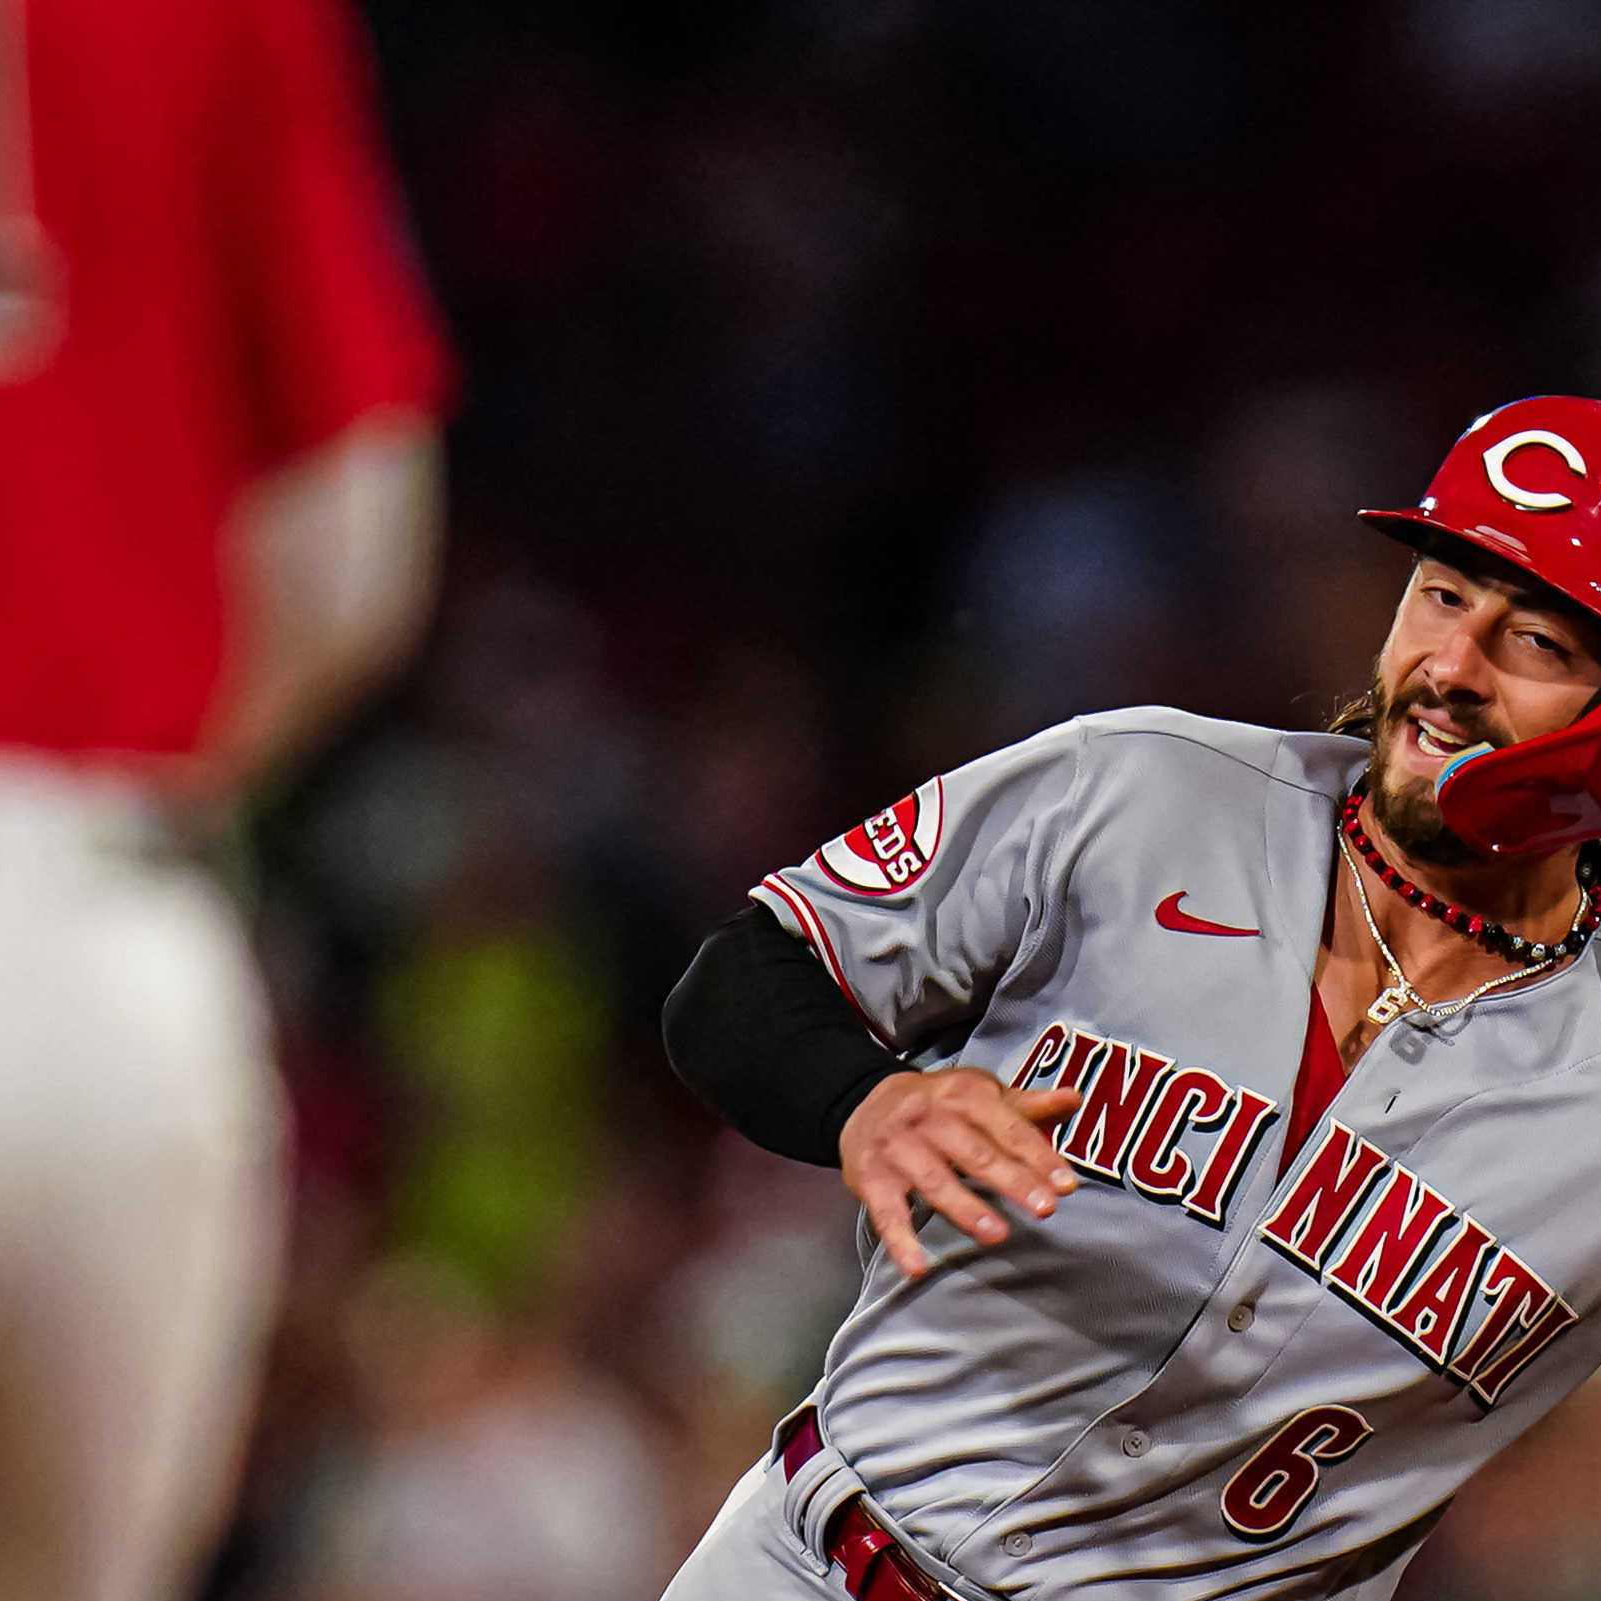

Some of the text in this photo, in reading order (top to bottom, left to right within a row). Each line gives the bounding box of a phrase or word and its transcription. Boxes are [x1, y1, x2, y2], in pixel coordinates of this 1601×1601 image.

[1482, 429, 1587, 510] C
[863, 804, 923, 885] EDS
[1220, 1404, 1375, 1544] 6
